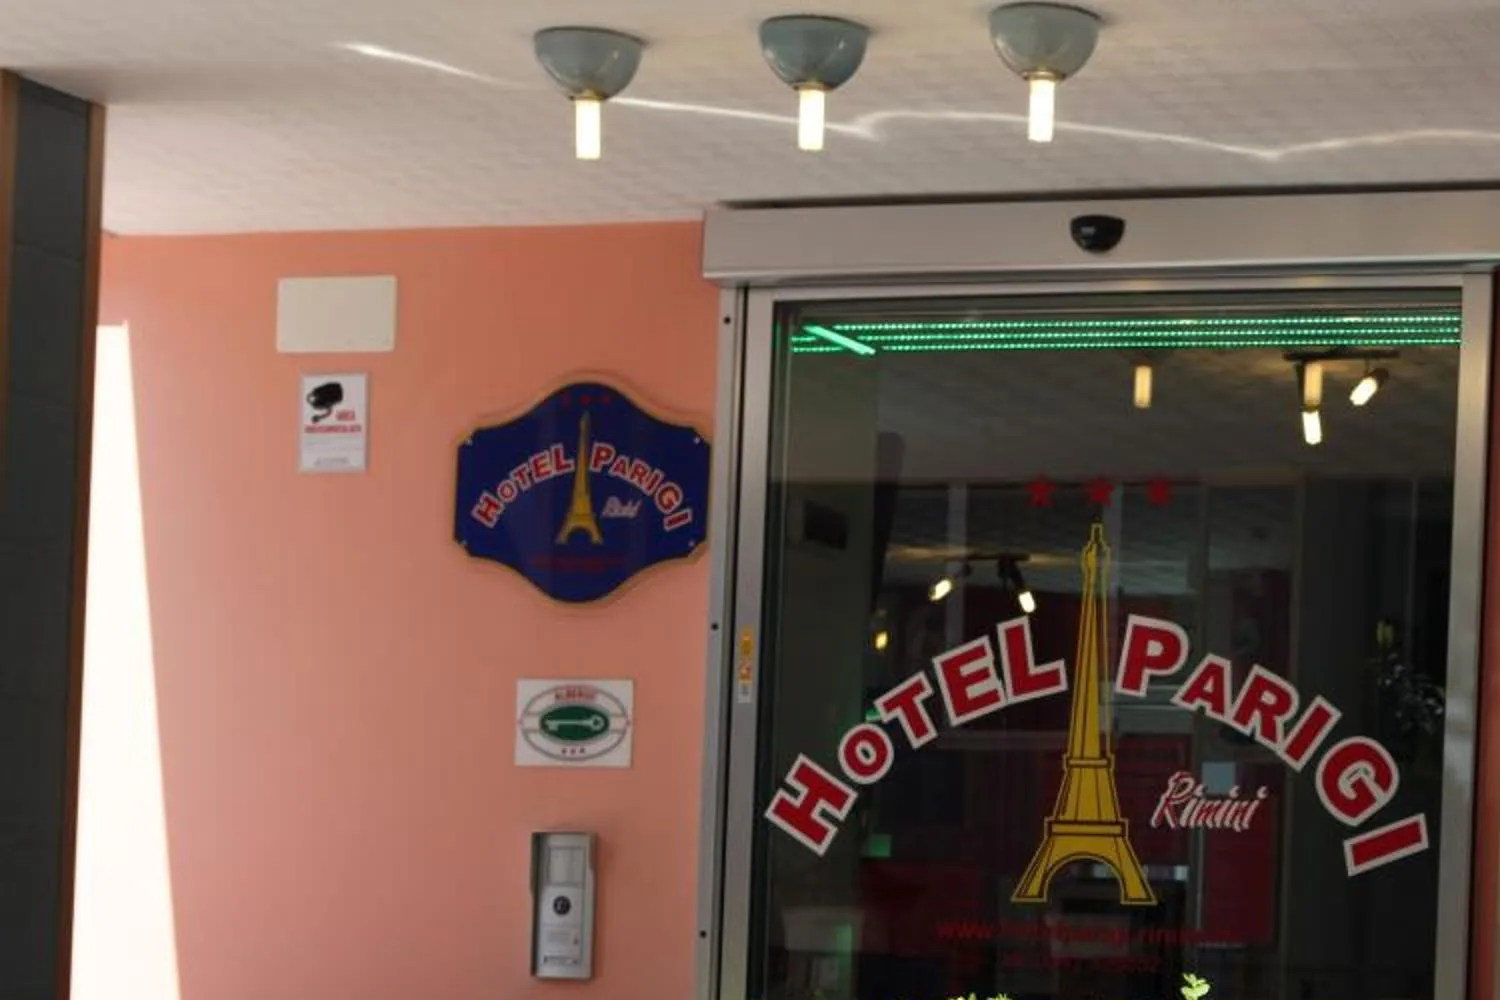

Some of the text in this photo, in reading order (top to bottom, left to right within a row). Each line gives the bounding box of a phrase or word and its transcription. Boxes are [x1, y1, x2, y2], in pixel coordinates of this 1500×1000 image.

[471, 442, 693, 531] HOTEL PARIGI
[764, 614, 1429, 877] HOTEL PARIGI
[1150, 770, 1270, 832] Rimini
